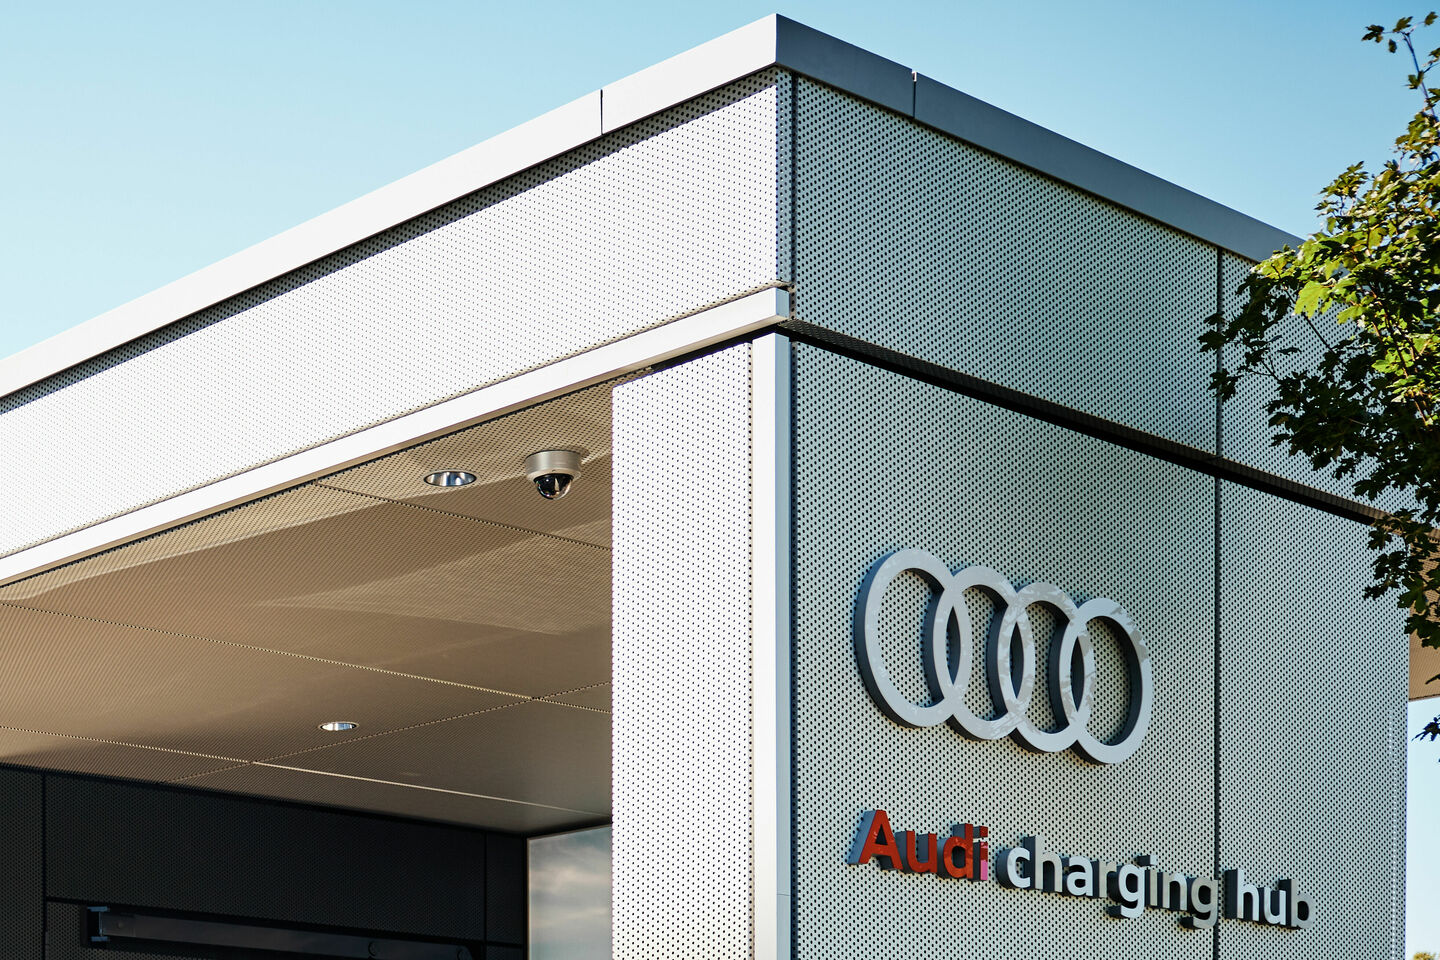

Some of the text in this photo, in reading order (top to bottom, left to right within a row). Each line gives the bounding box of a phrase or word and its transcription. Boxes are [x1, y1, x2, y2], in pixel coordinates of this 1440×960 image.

[847, 809, 1315, 930] Audi charging hub
